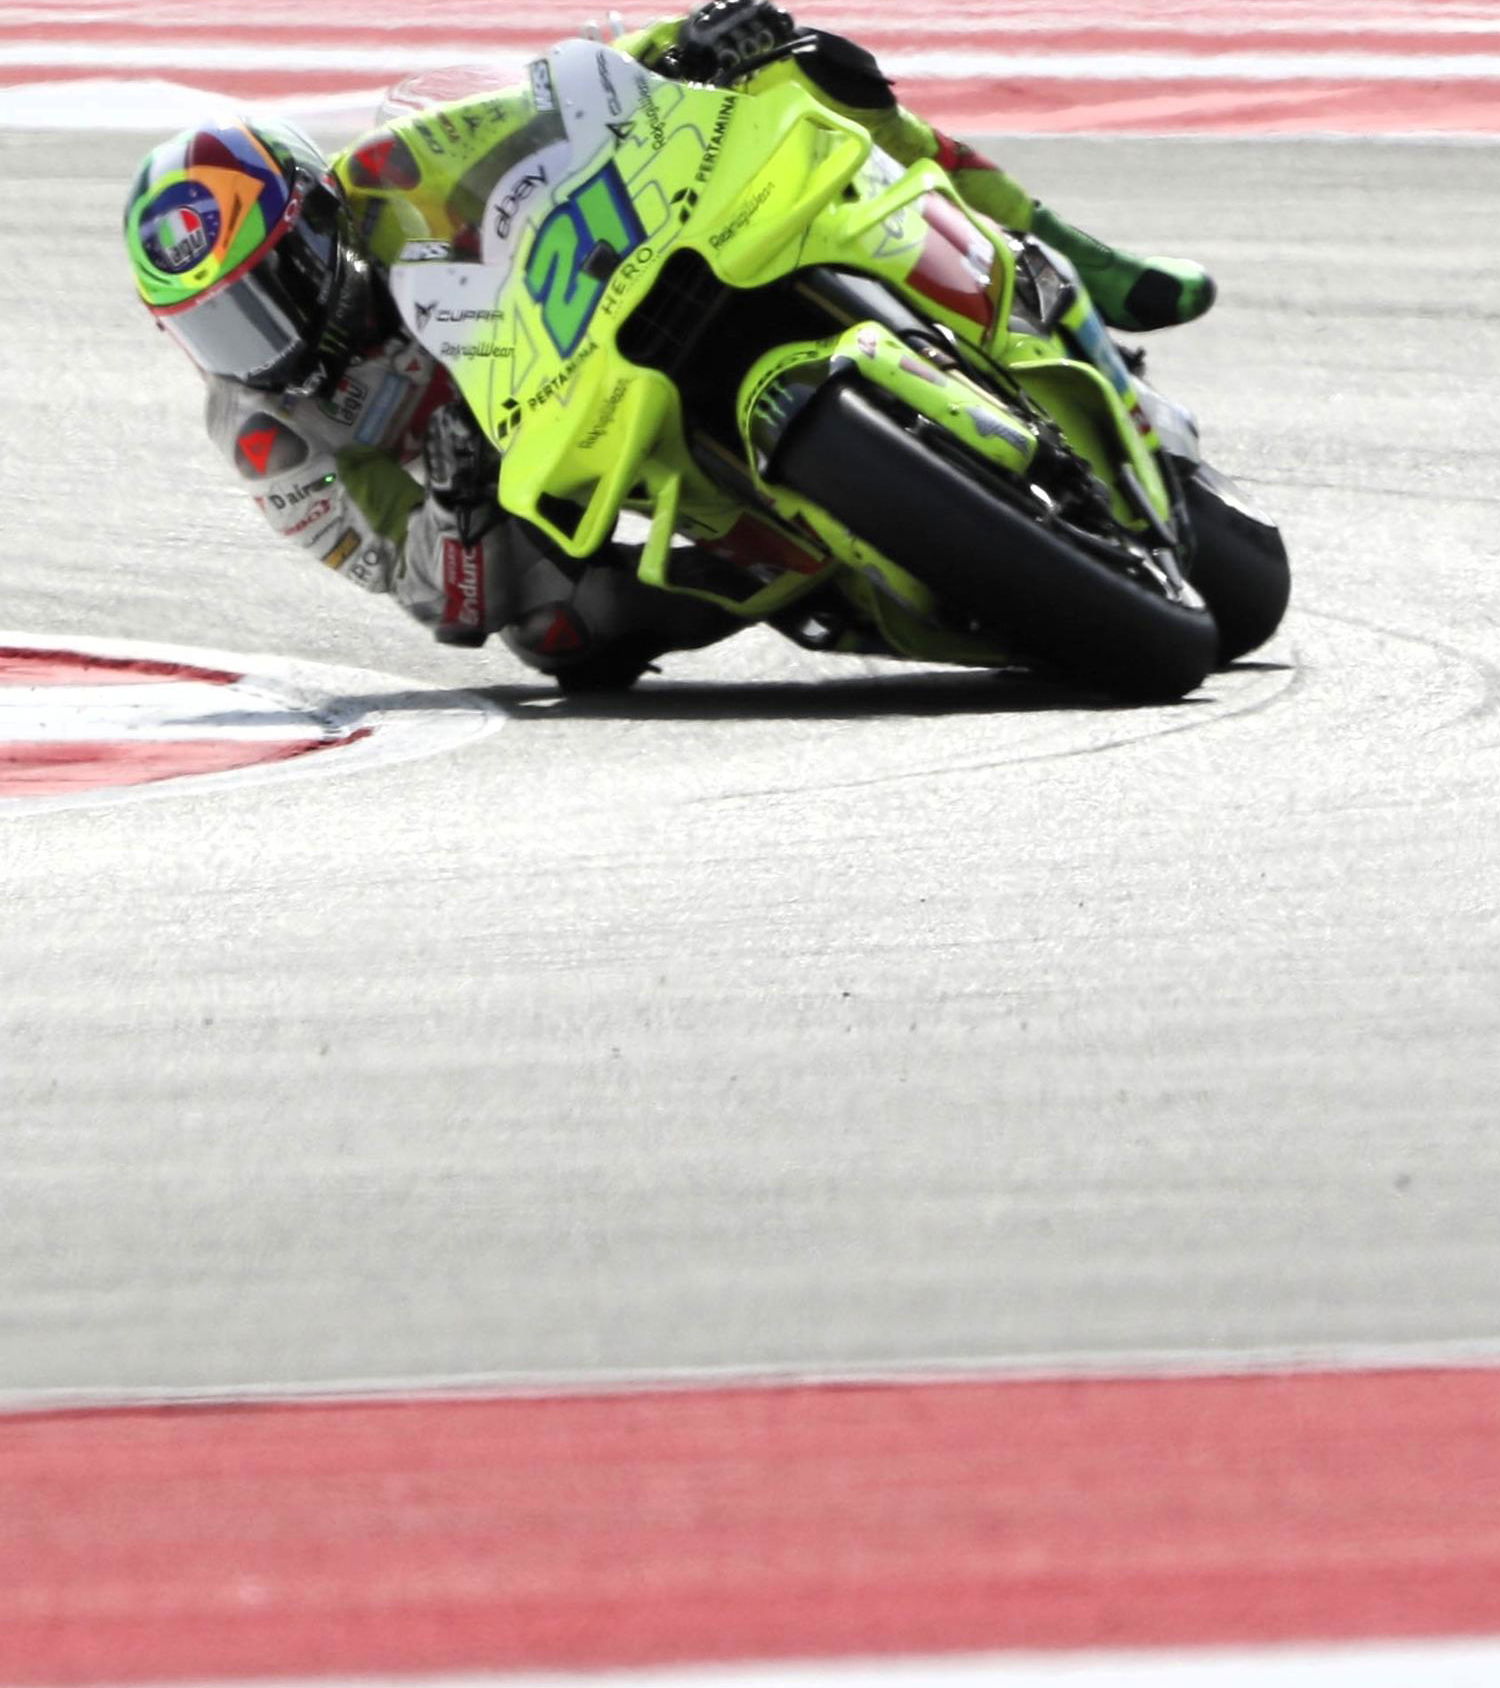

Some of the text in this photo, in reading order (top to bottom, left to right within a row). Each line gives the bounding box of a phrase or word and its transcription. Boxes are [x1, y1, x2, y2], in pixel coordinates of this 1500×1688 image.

[695, 95, 737, 182] PERTAMINA
[494, 165, 548, 239] ebay
[523, 158, 649, 359] 21
[602, 247, 653, 314] HERO
[436, 309, 504, 322] CUPRA
[527, 342, 598, 411] PERTAMINA
